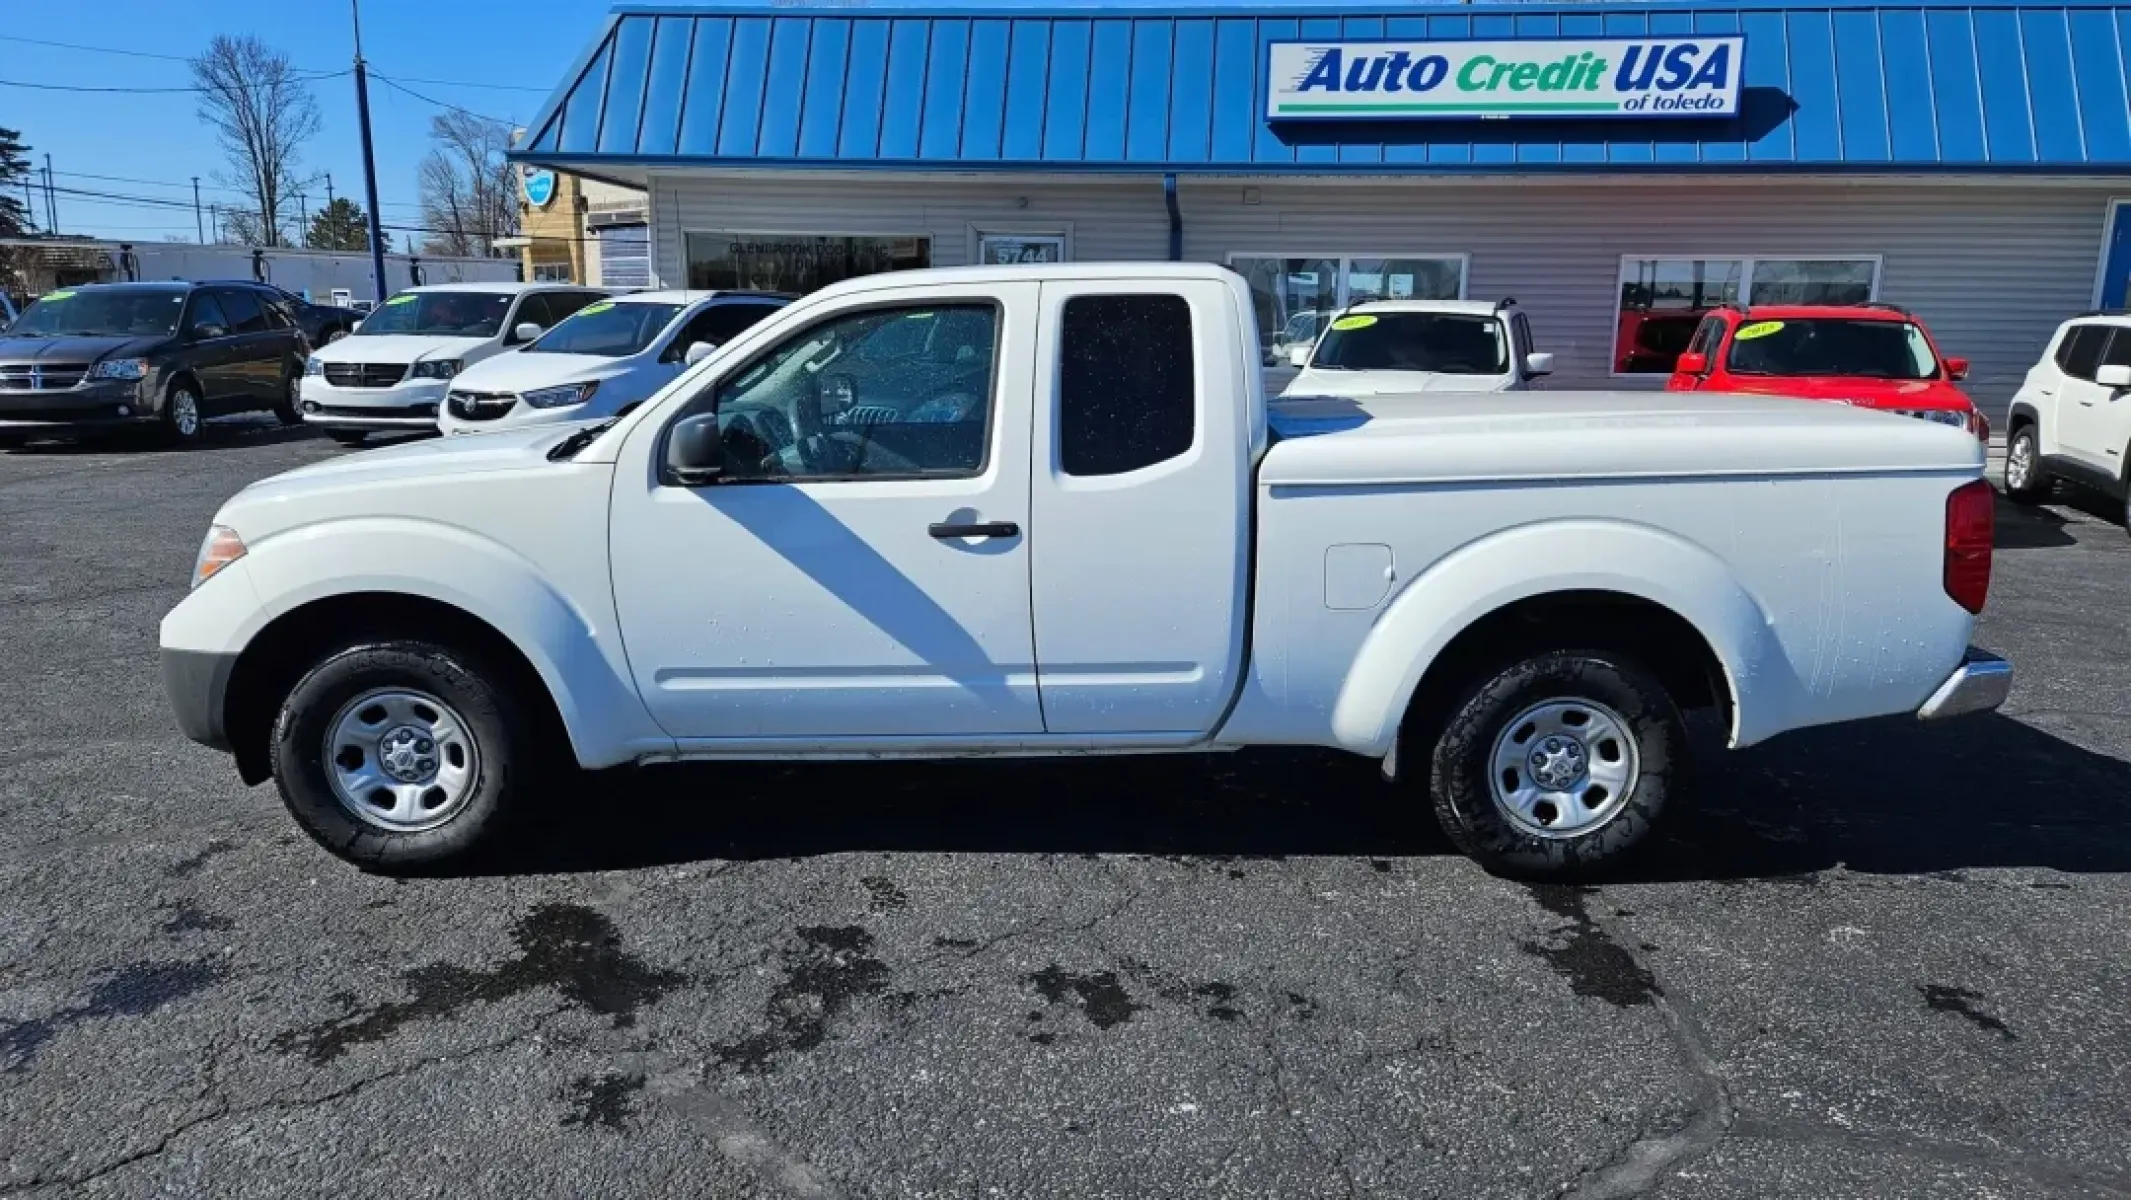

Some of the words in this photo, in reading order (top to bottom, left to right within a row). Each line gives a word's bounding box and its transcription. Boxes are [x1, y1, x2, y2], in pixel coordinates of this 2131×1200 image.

[1296, 48, 1449, 92] Auto
[1456, 51, 1608, 92] Credit
[1614, 43, 1730, 91] USA
[1624, 94, 1651, 110] of
[1653, 93, 1724, 110] toledo
[997, 248, 1048, 264] 5744
